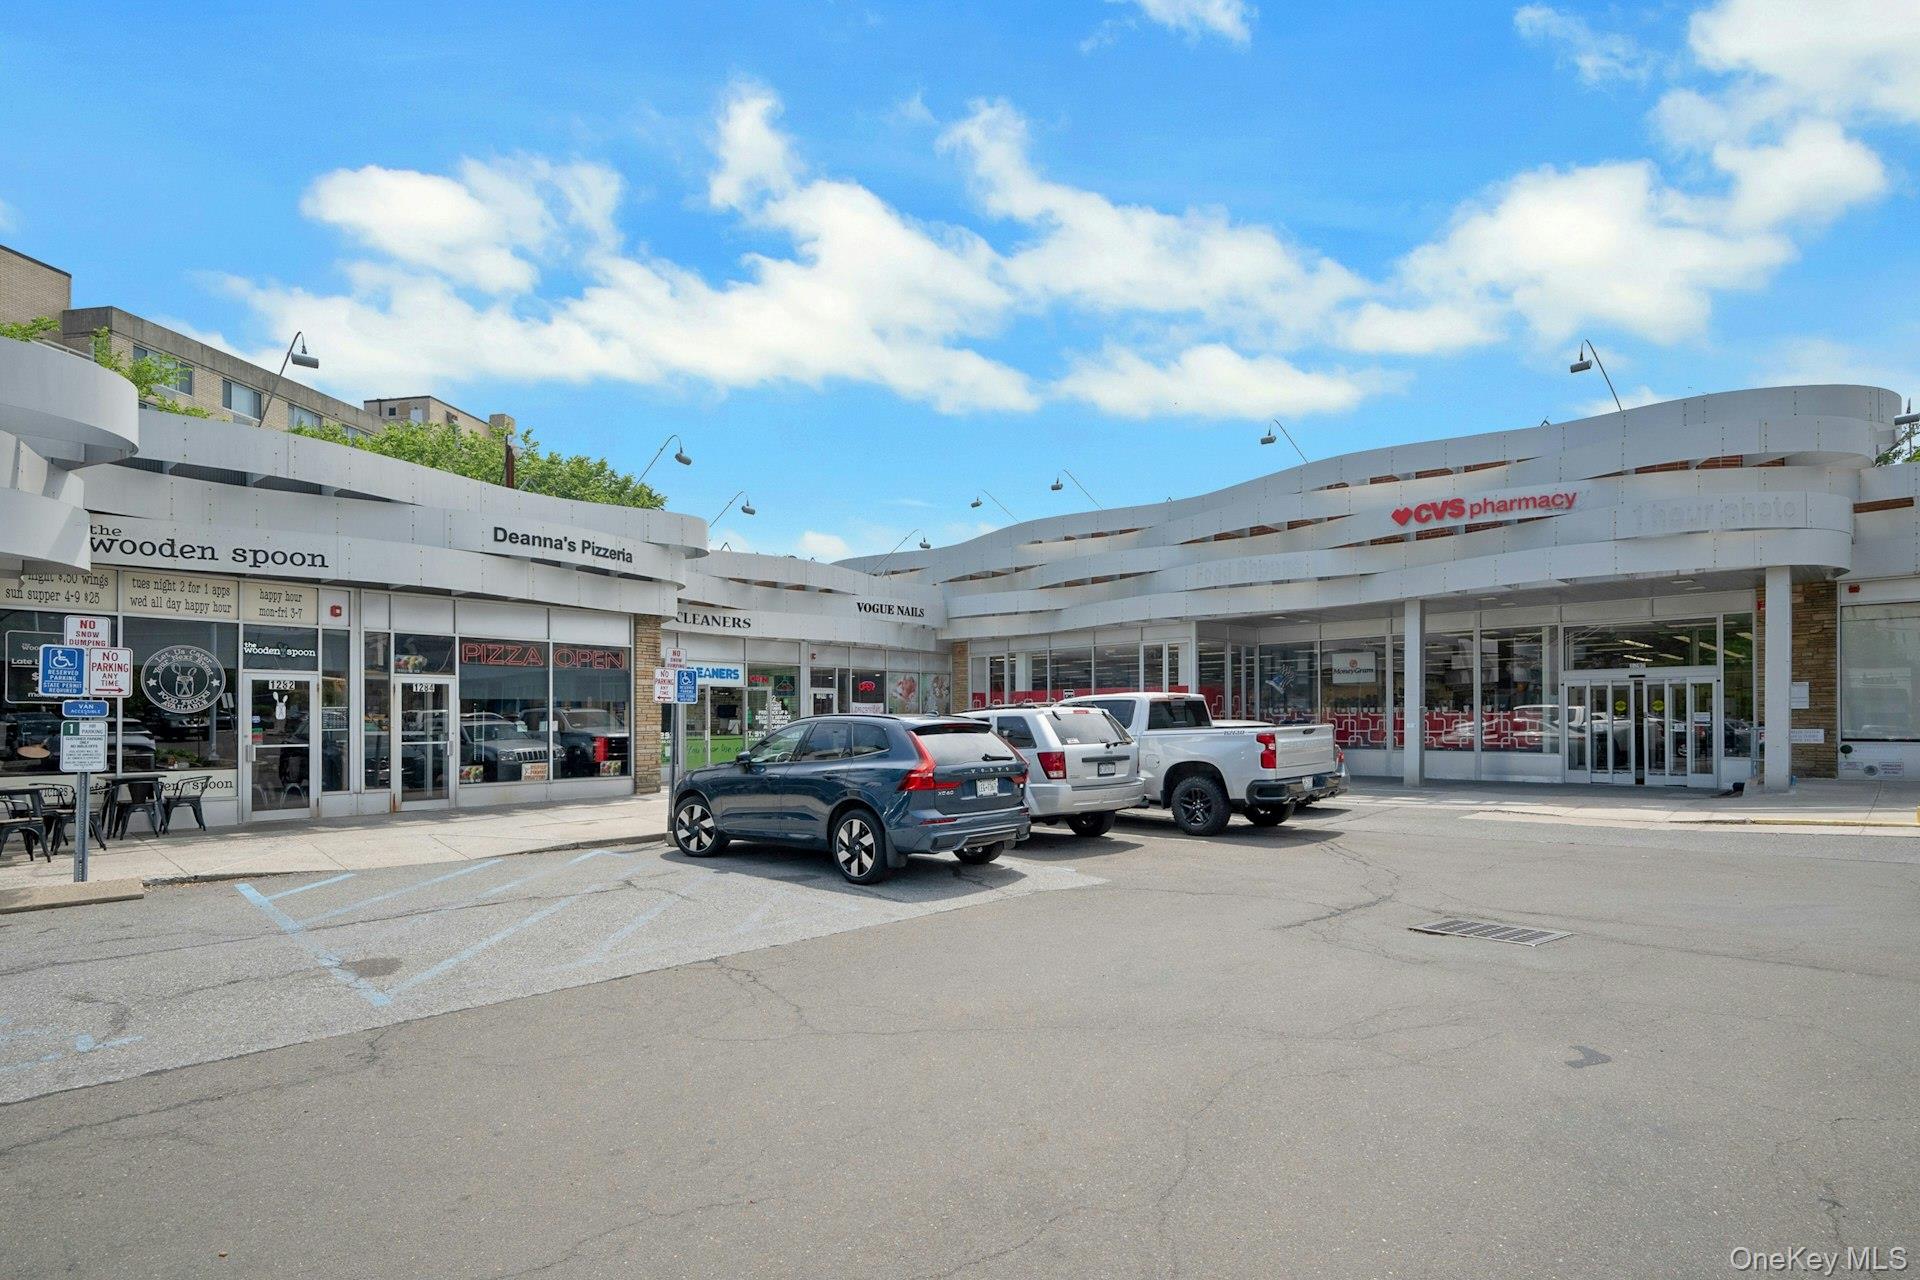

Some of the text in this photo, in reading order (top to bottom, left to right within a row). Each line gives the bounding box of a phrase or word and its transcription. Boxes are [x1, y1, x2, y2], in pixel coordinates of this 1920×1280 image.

[1414, 492, 1577, 524] CVS pharmacy
[90, 524, 122, 537] the
[494, 526, 632, 564] Deanna's Pizzeria
[232, 548, 330, 568] spoon
[82, 574, 109, 590] wings
[132, 578, 230, 598] tues night 2 for 1 apps
[6, 588, 100, 604] sun supper 4-9 $25
[259, 589, 302, 604] happy hour
[130, 596, 232, 614] wed all day happy hour
[856, 602, 925, 617] VOGUE NAILS
[259, 607, 302, 620] mon-fri 3-7
[676, 611, 751, 629] CLEANERS
[80, 620, 96, 629] NO
[102, 652, 118, 661] NO
[244, 647, 316, 657] wooden spoon
[462, 643, 624, 670] PIZZA OPEN
[91, 663, 129, 672] PARKING
[69, 724, 74, 734] 1
